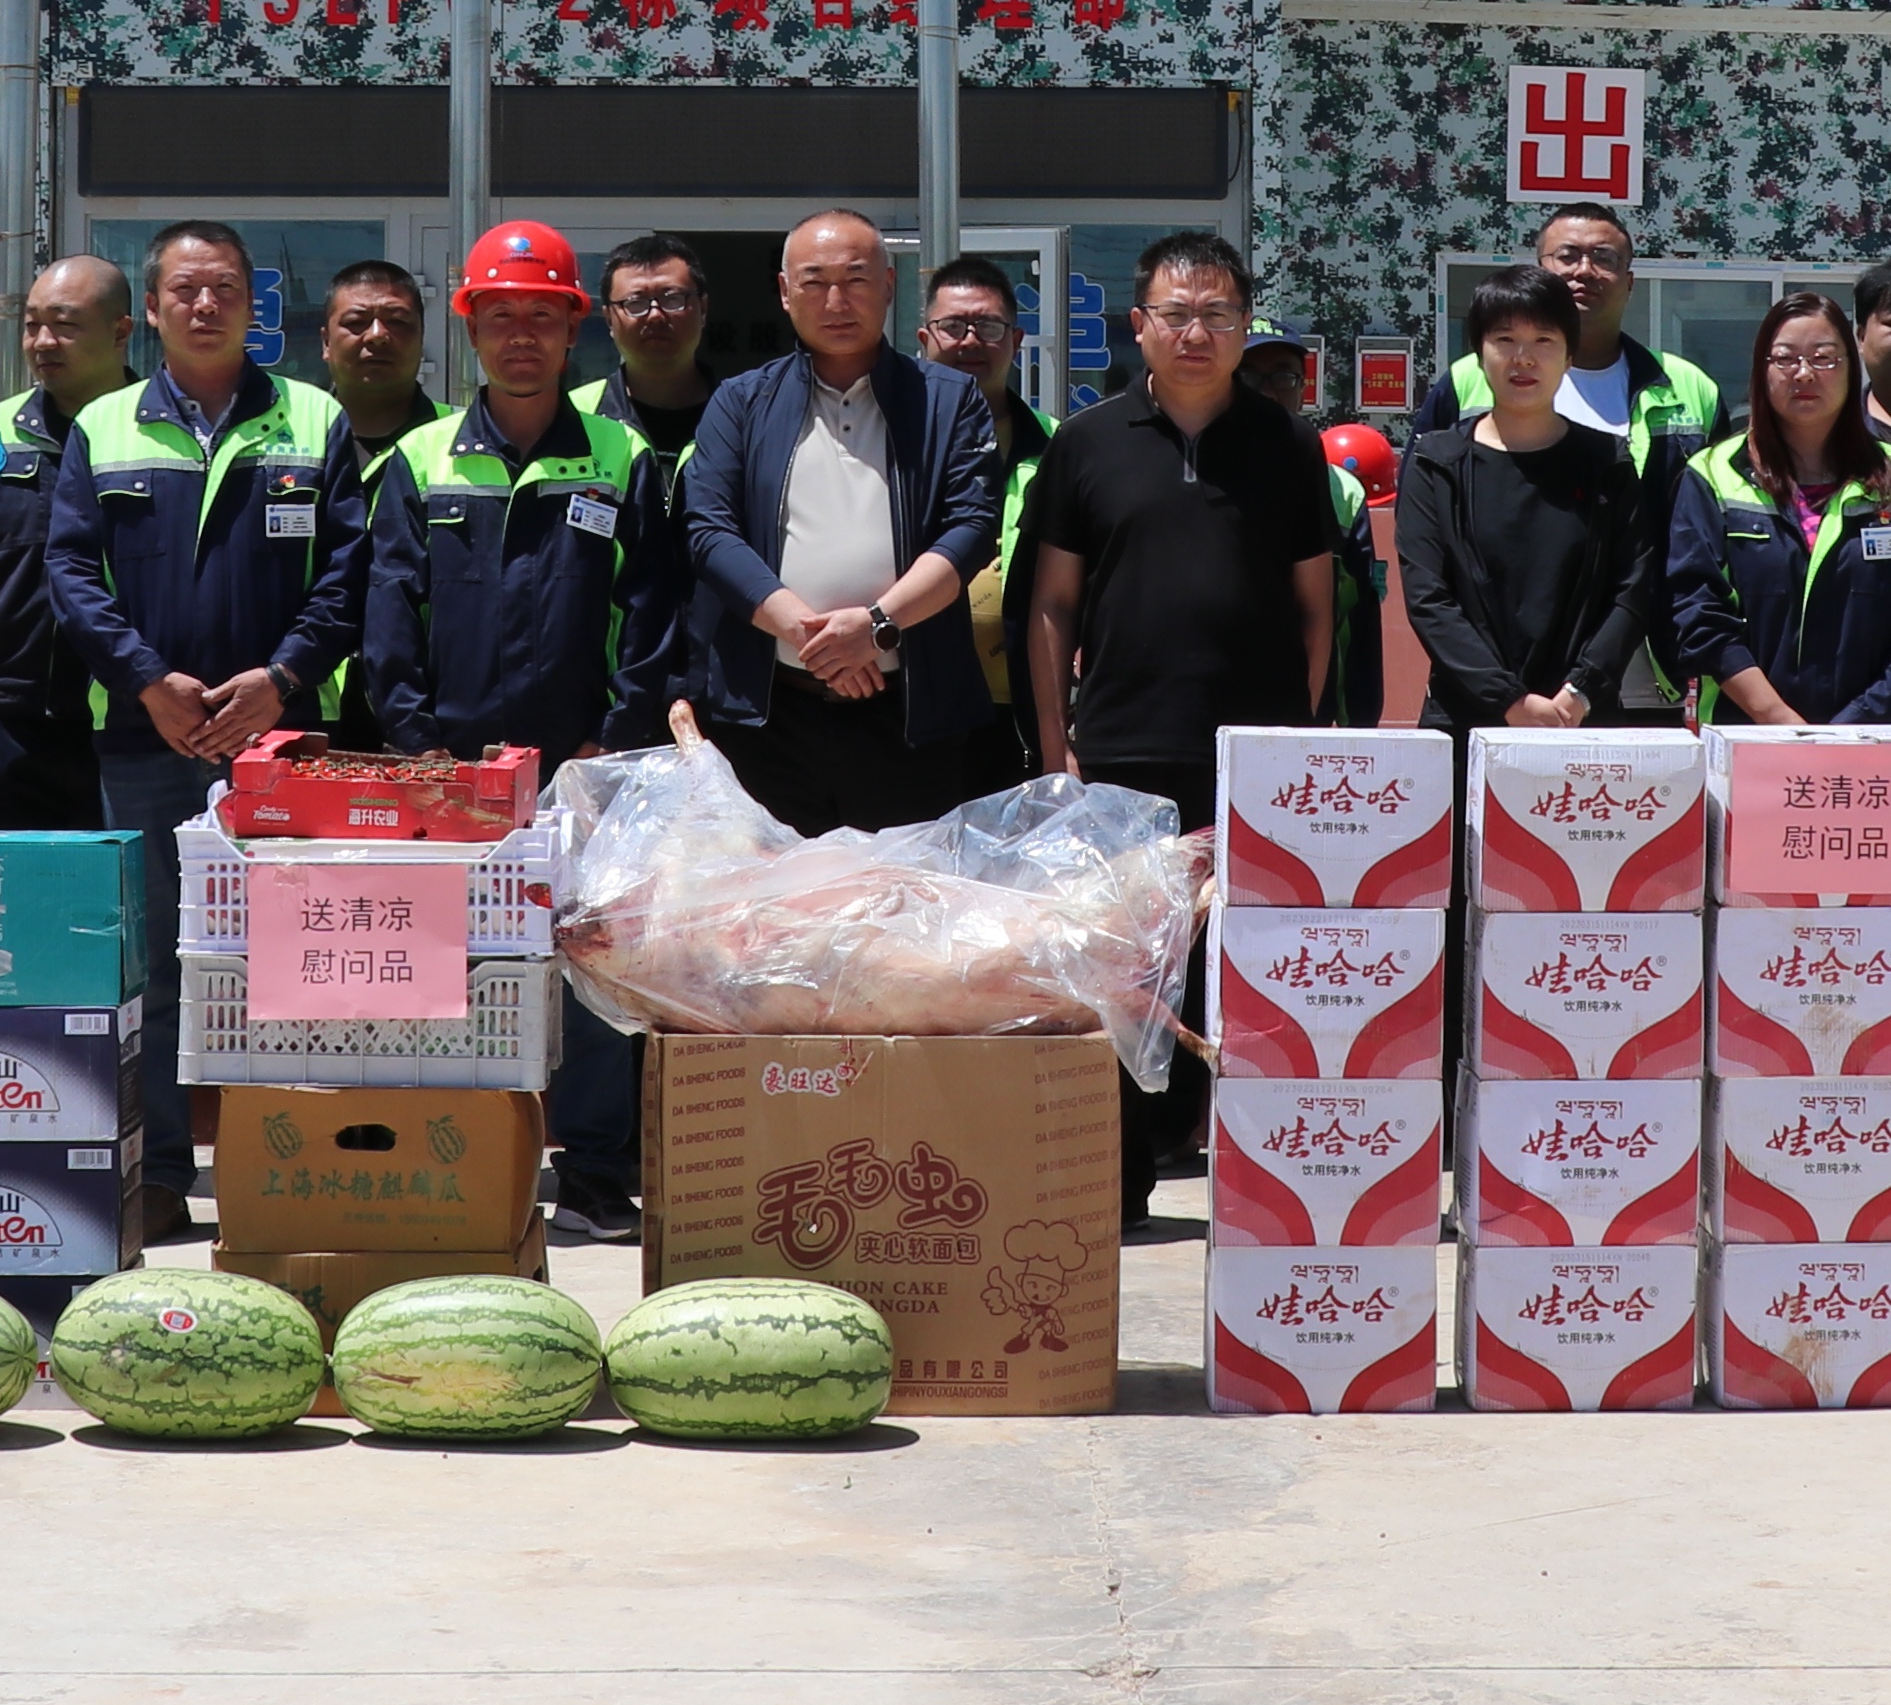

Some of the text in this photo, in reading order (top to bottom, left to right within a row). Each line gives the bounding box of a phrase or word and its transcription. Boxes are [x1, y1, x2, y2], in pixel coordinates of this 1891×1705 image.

[1520, 73, 1630, 199] 出
[1272, 774, 1405, 814] 娃哈哈
[1531, 783, 1664, 822] 娃哈哈
[1784, 775, 1889, 809] 送清凉
[1783, 826, 1888, 860] 慰问品
[301, 896, 413, 931] 送清凉
[301, 949, 412, 984] 慰问品
[1267, 948, 1402, 987] 娃哈哈
[1526, 953, 1660, 993] 娃哈哈
[1761, 947, 1891, 986] 娃哈哈
[716, 1067, 746, 1082] FOODS
[763, 1062, 840, 1096] 豪旺达
[1264, 1117, 1397, 1157] 娃哈哈
[1523, 1121, 1654, 1160] 娃哈哈
[753, 1137, 988, 1271] 毛毛虫
[857, 1234, 981, 1264] 夹心软面包
[893, 1280, 949, 1295] CAKE
[1258, 1285, 1390, 1324] 娃哈哈
[1520, 1285, 1651, 1324] 娃哈哈
[899, 1360, 1008, 1379] 品有限公司
